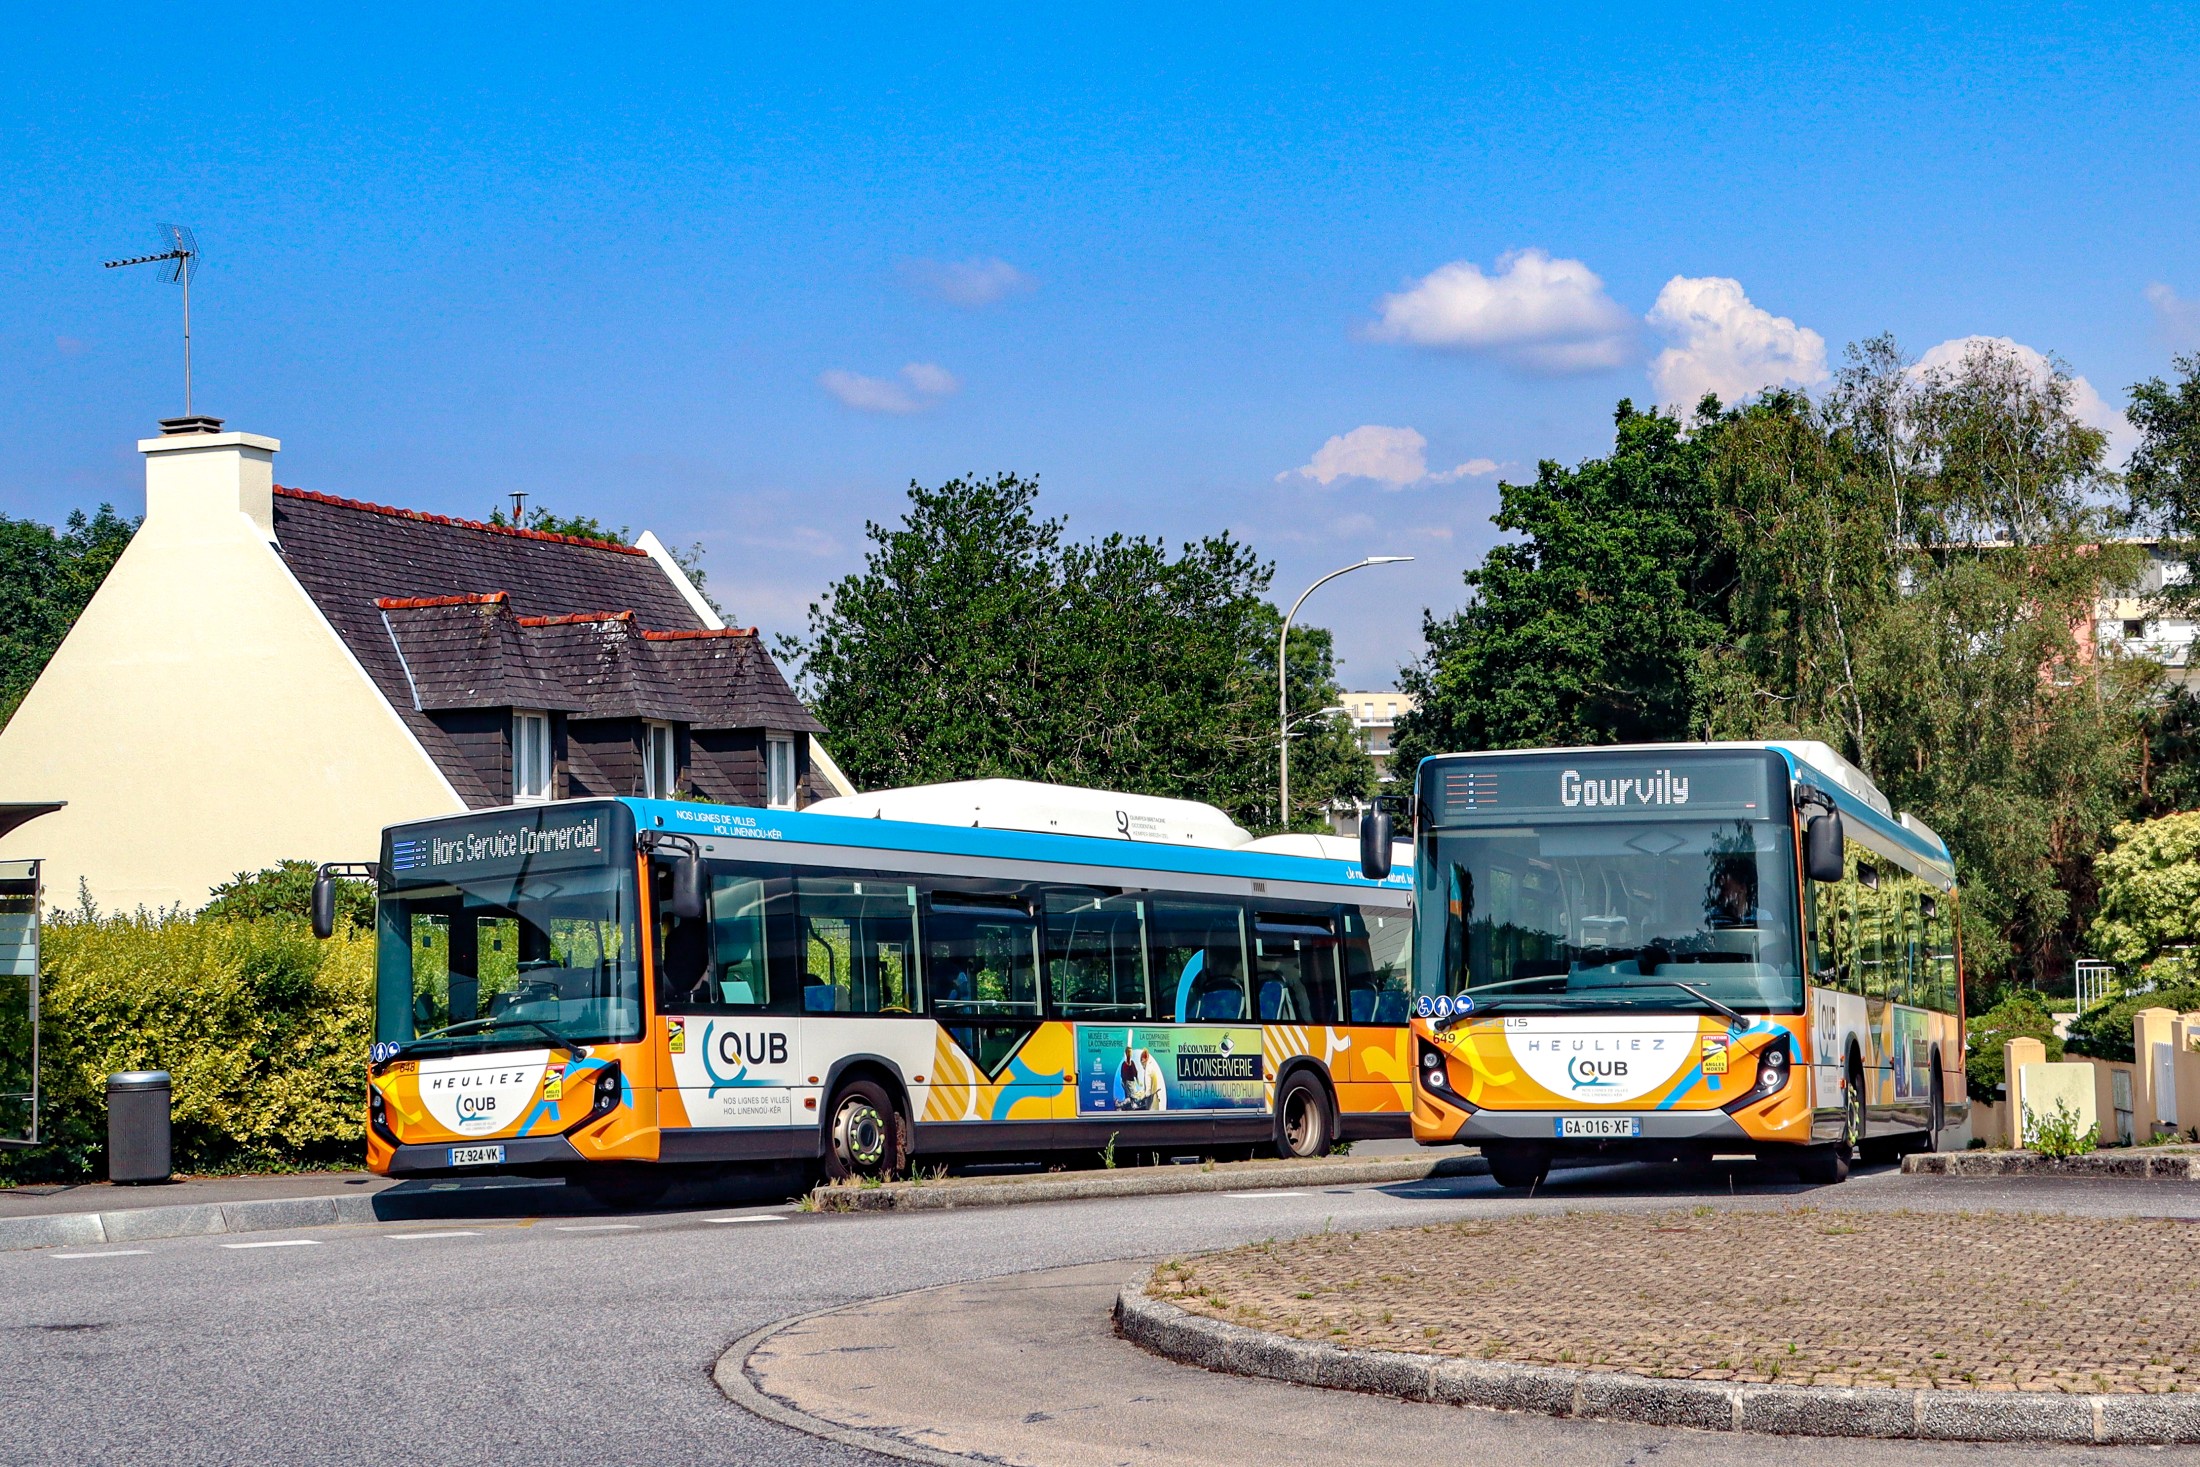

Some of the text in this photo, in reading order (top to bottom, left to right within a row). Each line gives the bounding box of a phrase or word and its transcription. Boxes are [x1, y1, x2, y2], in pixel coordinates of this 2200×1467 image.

[1561, 770, 1689, 806] Gourvily
[676, 810, 756, 826] NOS LIGNES DE VILLES
[714, 826, 729, 835] HOL
[432, 838, 464, 866] Hors
[467, 830, 517, 861] Service
[520, 818, 598, 854] Commercial
[1821, 1004, 1836, 1041] QUB
[1433, 1033, 1455, 1044] 649
[1528, 1039, 1665, 1052] HEULIEZ
[719, 1031, 788, 1066] QUB
[1178, 1042, 1217, 1053] DÉCOUVREZ
[1178, 1058, 1253, 1077] LA CONSERVERIE
[1580, 1061, 1628, 1076] QUB
[433, 1072, 524, 1089] HEULIEZ
[1180, 1083, 1201, 1097] D'HIER
[1211, 1083, 1254, 1097] AUJOURD'HUI
[464, 1097, 496, 1112] QUB
[738, 1096, 759, 1104] LIGNES
[761, 1096, 769, 1104] DE
[770, 1096, 789, 1104] VILLES
[723, 1107, 736, 1115] HOL
[1565, 1120, 1630, 1133] GA-016-XF
[454, 1148, 498, 1163] FZ-924-VK
